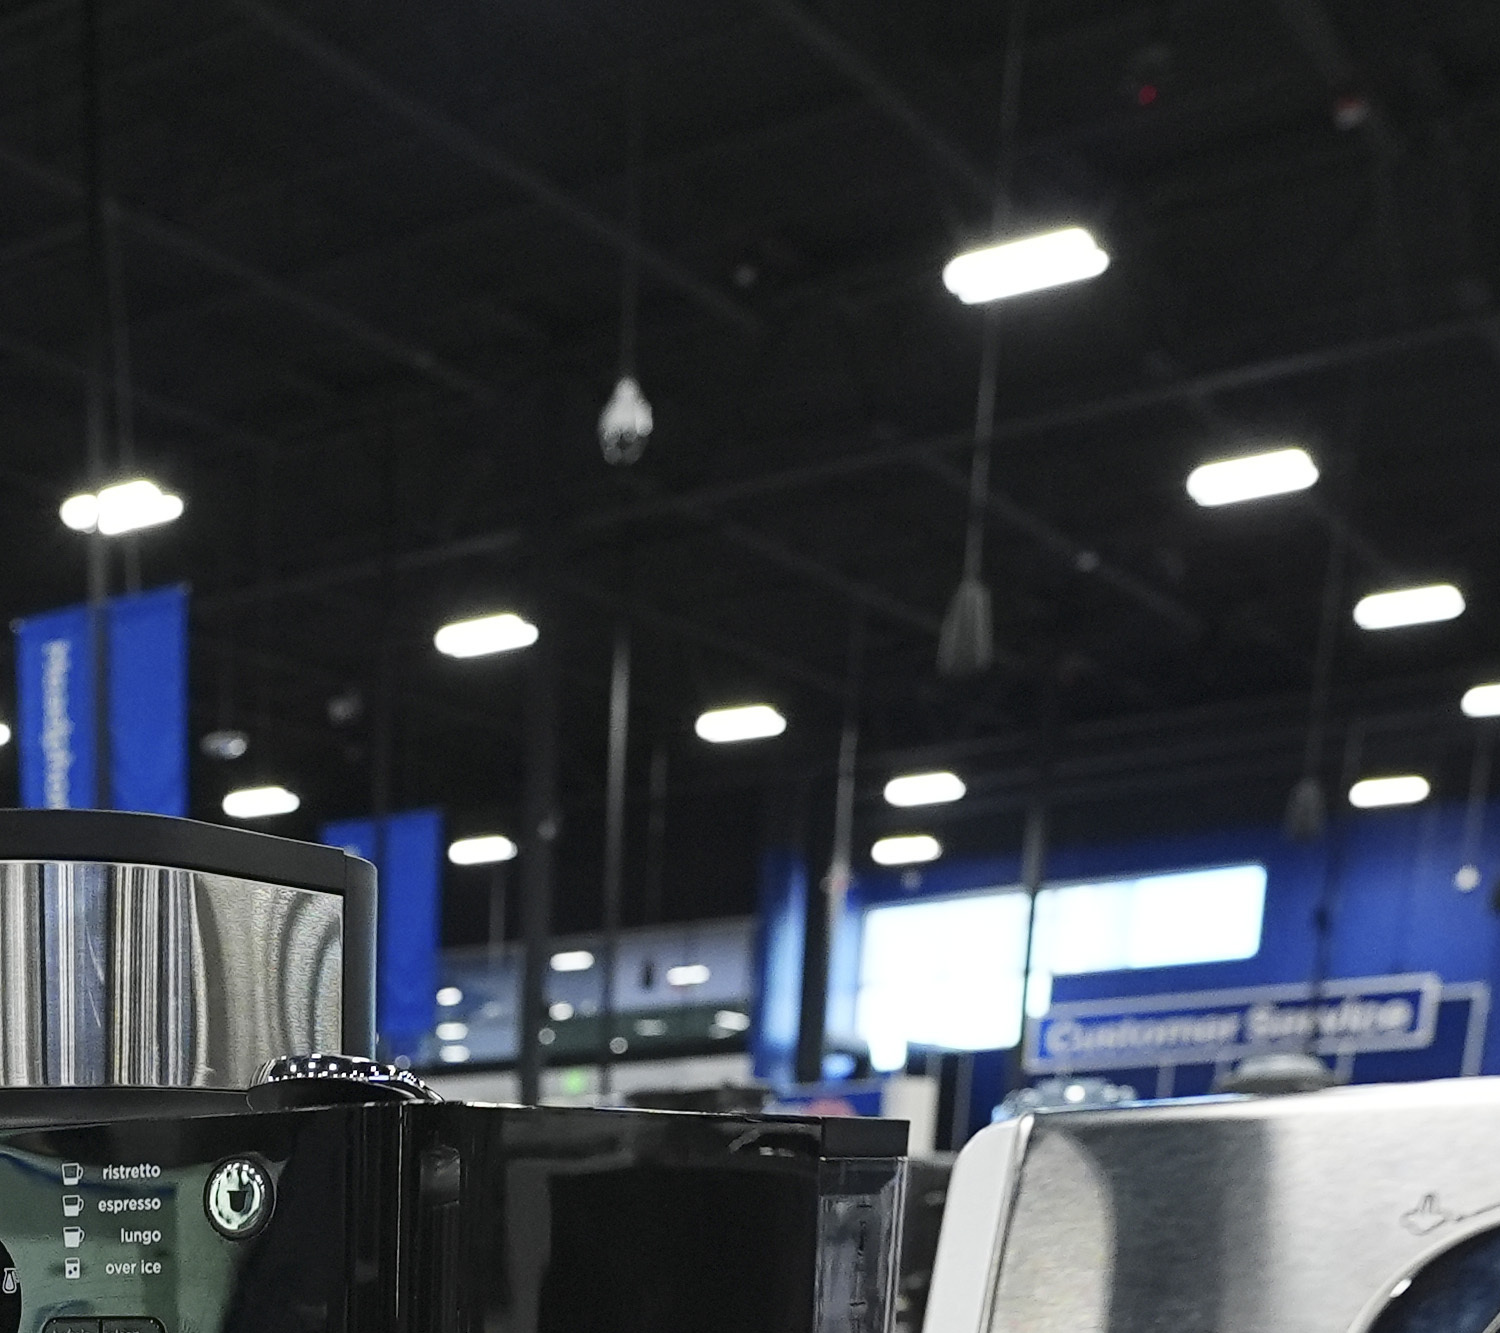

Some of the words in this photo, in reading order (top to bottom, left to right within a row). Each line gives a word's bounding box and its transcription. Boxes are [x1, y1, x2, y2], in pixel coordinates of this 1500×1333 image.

[1046, 1014, 1241, 1056] Customer
[1245, 1000, 1414, 1041] Service
[103, 1163, 161, 1180] ristretto
[98, 1197, 161, 1214] espresso
[121, 1228, 162, 1245] lungo
[106, 1262, 136, 1275] over
[141, 1260, 162, 1274] ice
